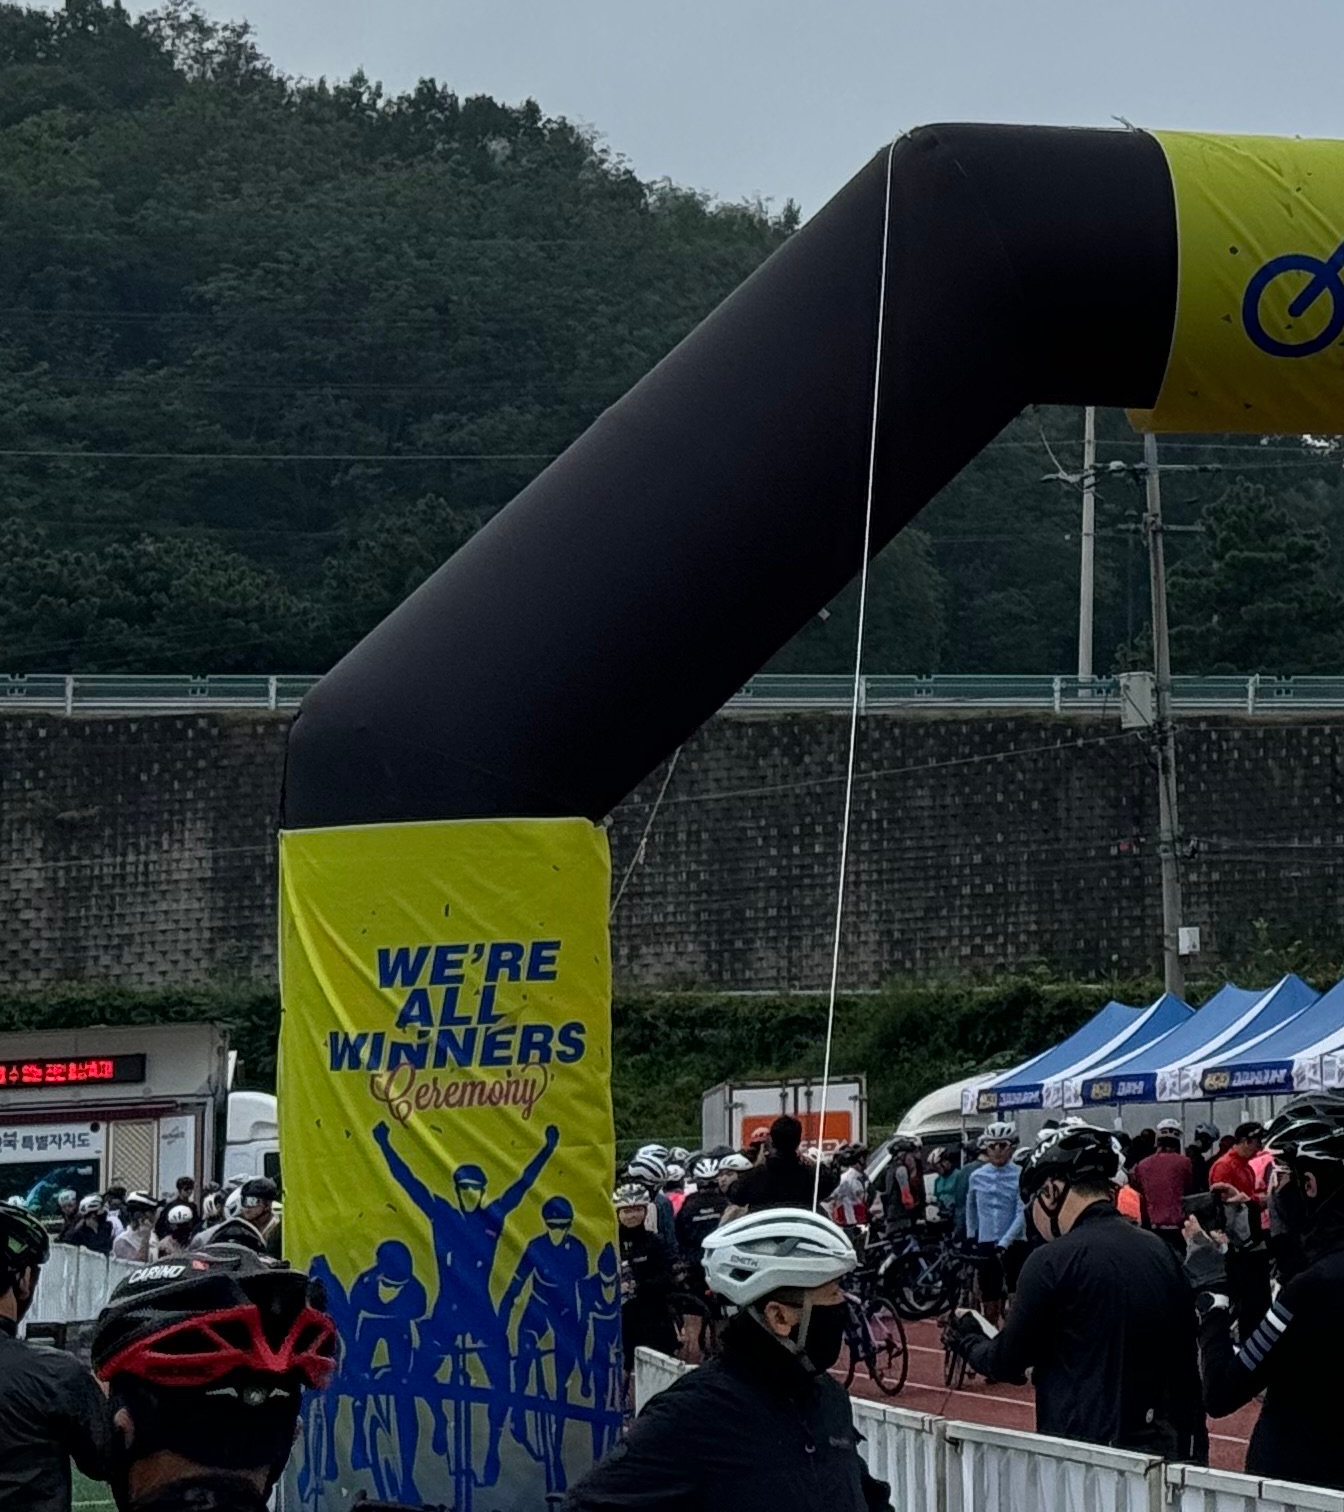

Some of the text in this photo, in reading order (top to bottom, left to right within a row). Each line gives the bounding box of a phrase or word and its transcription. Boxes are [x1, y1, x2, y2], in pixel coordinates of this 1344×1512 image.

[378, 940, 561, 989] WE'RE
[396, 985, 506, 1029] ALL
[329, 1022, 587, 1072] WINNERS
[371, 1062, 548, 1128] Ceremony
